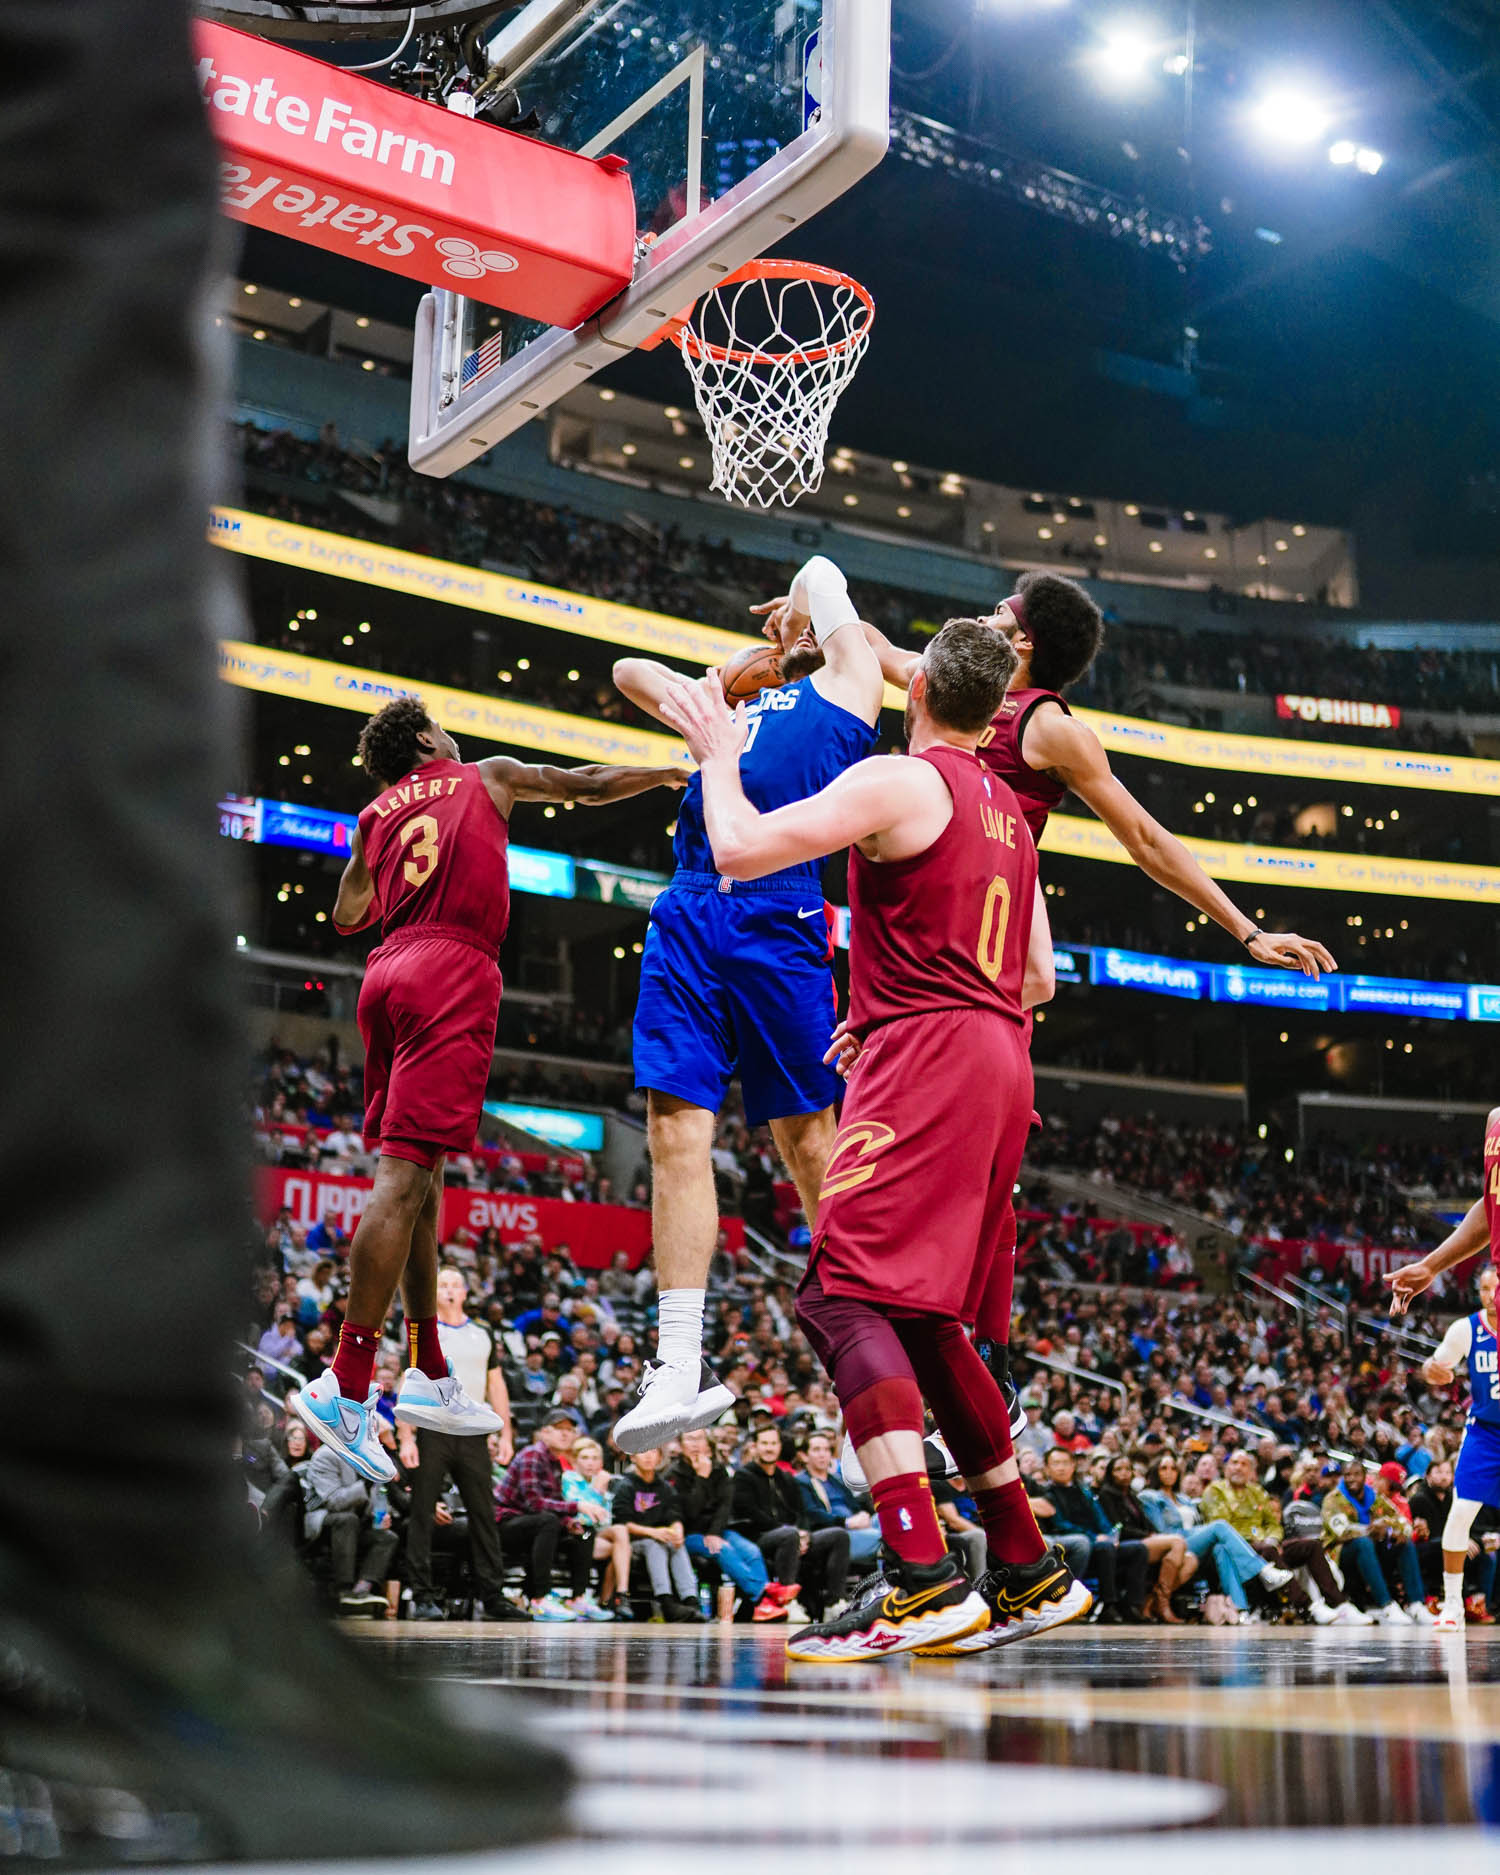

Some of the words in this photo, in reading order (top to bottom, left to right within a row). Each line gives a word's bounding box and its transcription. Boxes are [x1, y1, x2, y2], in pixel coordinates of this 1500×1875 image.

[1284, 694, 1392, 728] TOSHIBA
[400, 814, 439, 888] 3
[976, 874, 1011, 982] 0
[1106, 949, 1197, 989] Spectrum
[468, 1197, 538, 1232] aws
